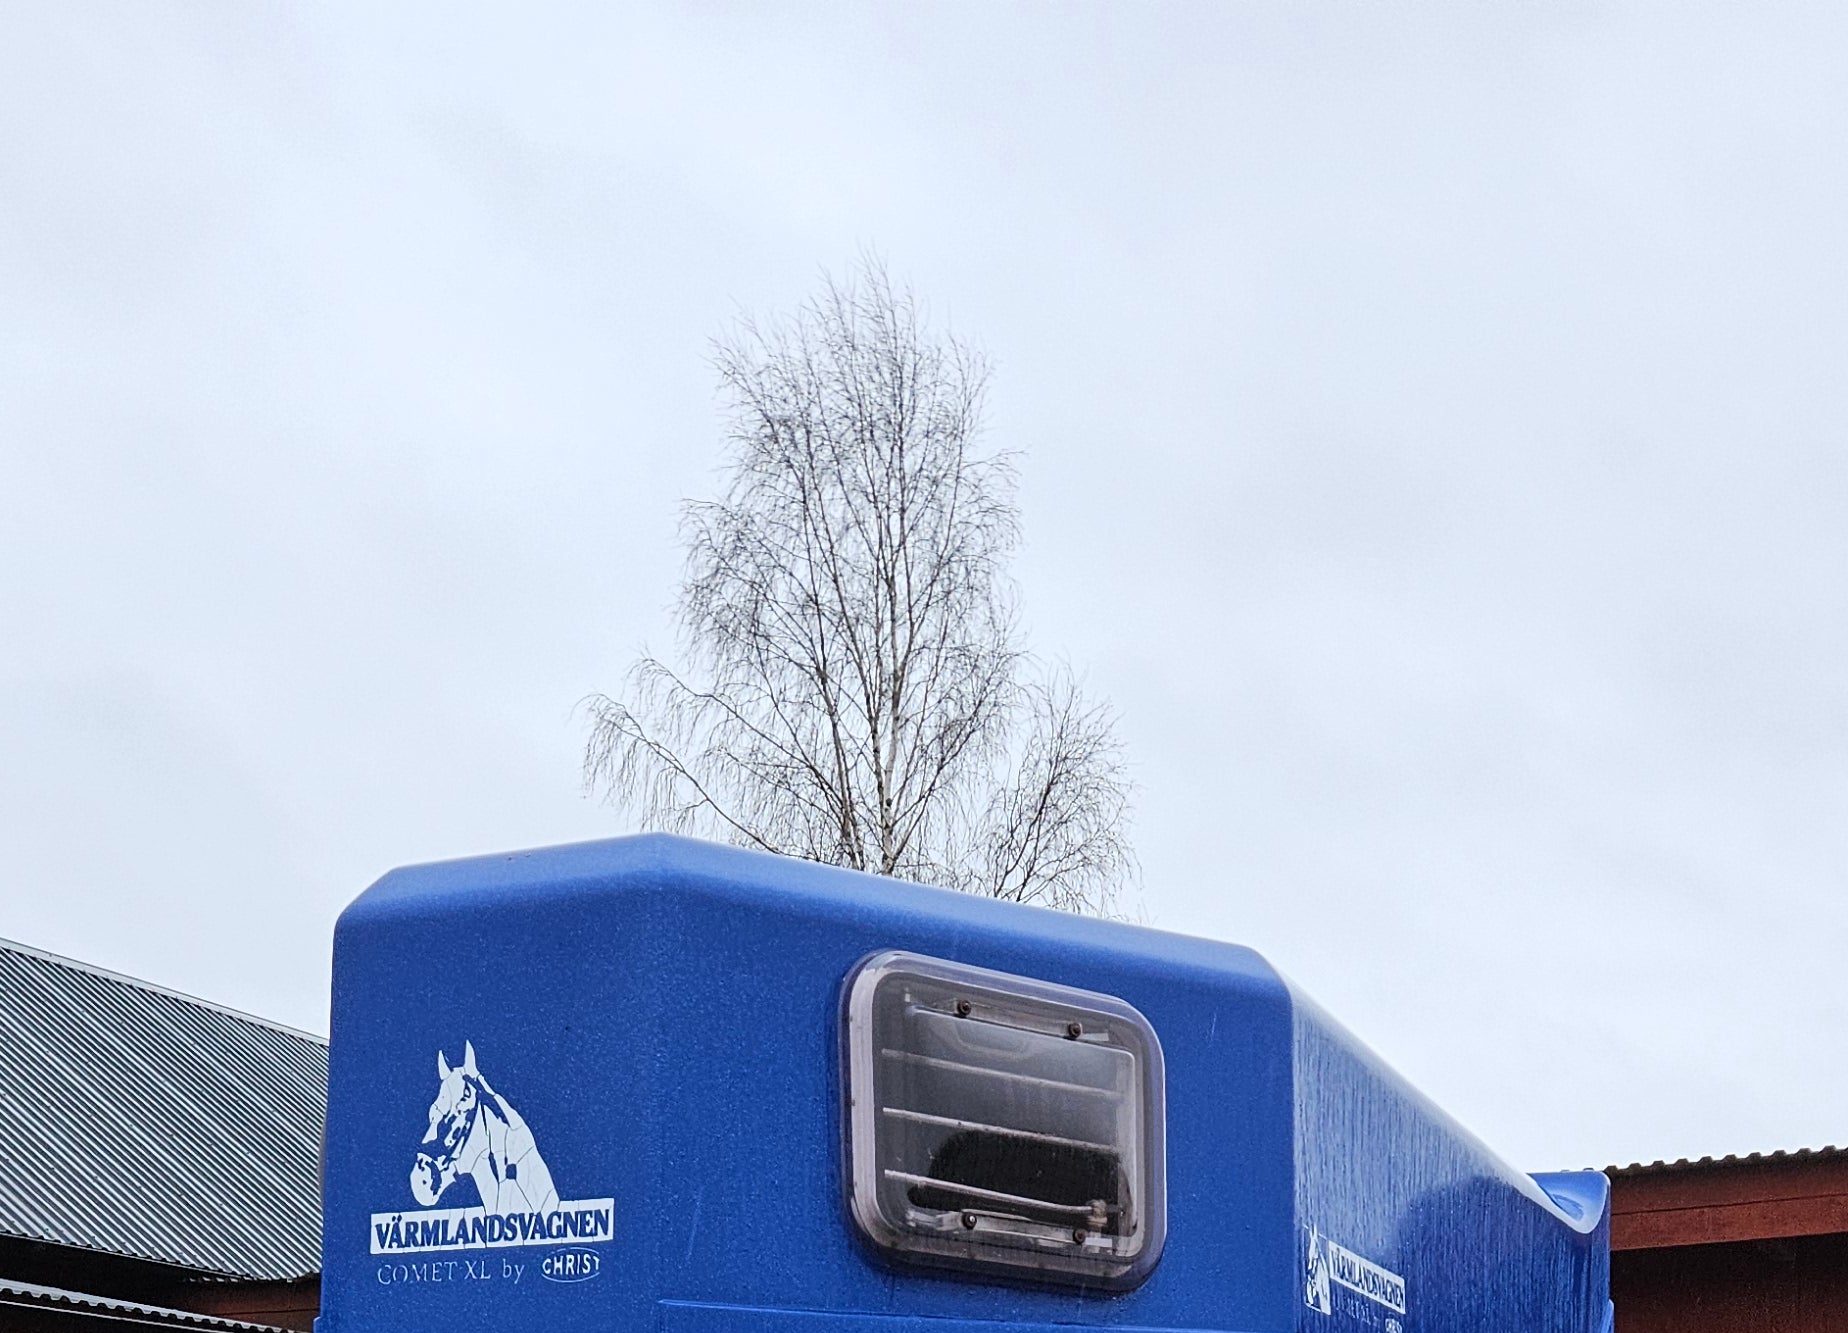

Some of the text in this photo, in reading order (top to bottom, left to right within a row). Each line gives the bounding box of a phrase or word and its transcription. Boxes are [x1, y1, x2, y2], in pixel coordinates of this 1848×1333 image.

[374, 1208, 610, 1250] VÄRMLANDSVAGNEN
[377, 1252, 600, 1285] COMET XL by CHRIST
